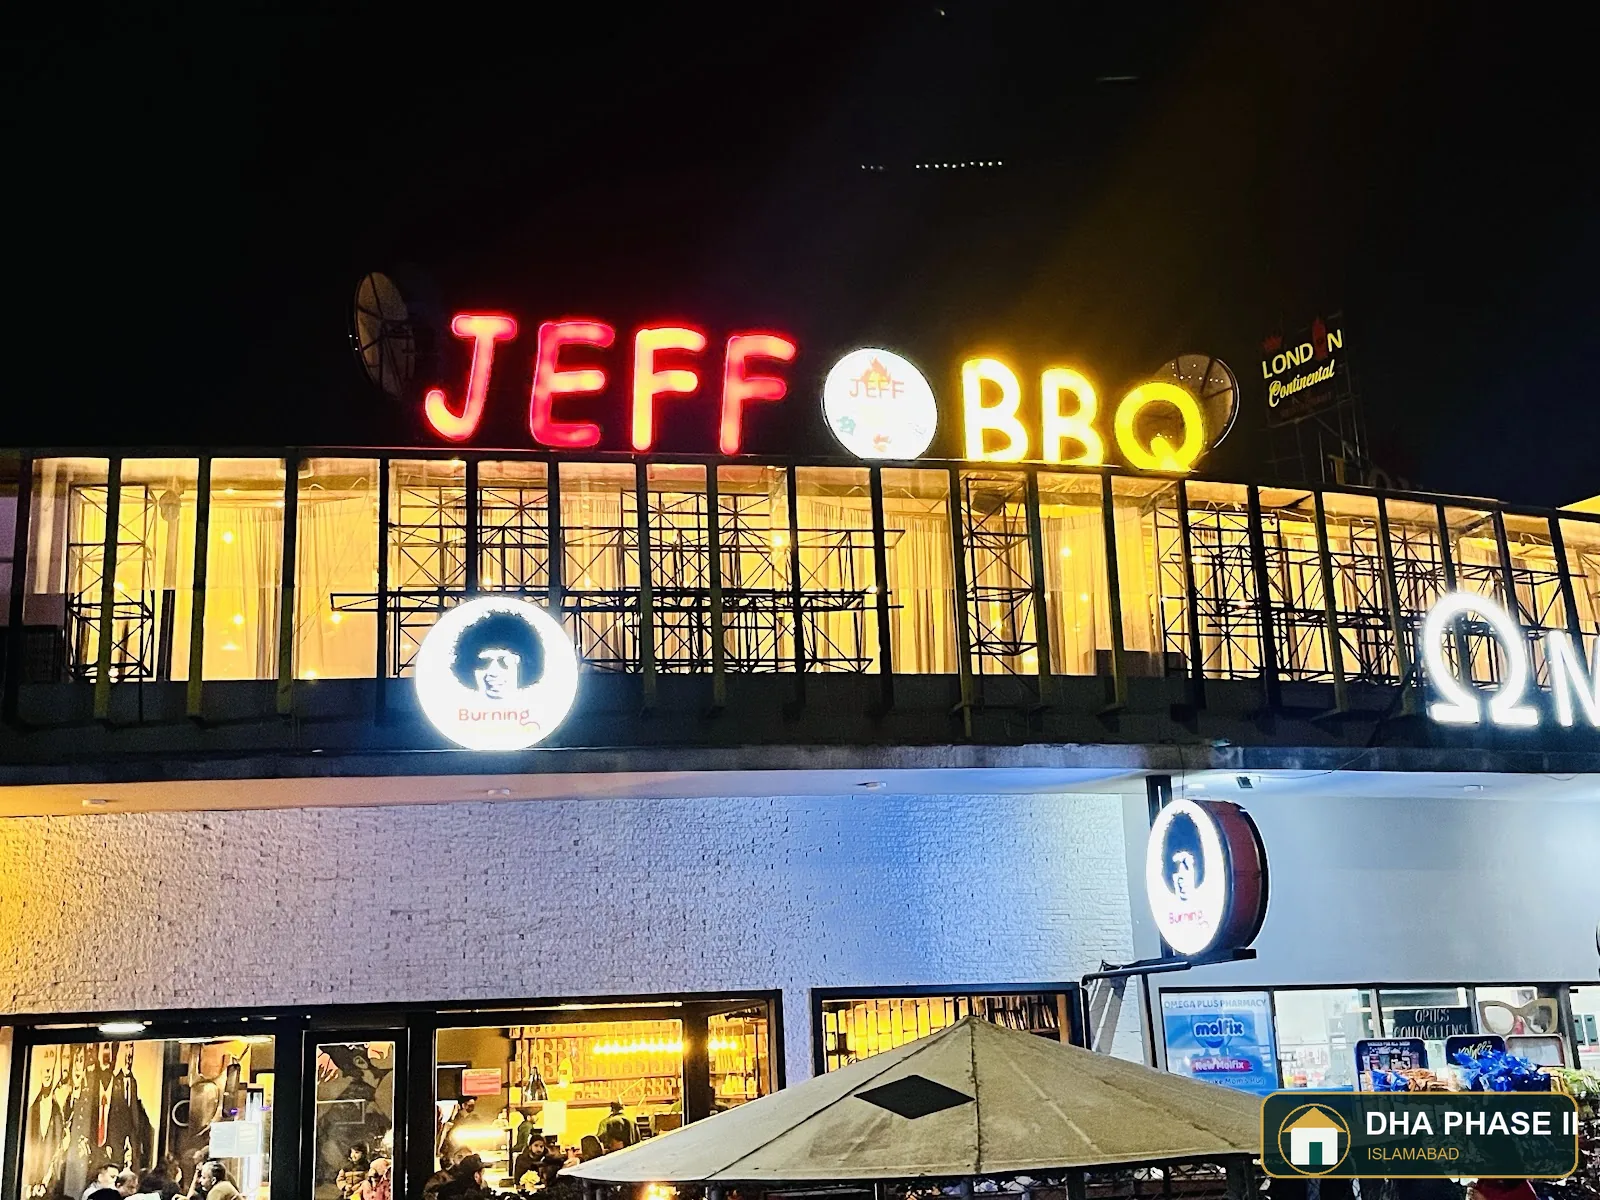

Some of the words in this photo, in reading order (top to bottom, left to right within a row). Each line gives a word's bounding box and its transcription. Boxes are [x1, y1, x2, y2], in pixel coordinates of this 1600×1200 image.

[1262, 329, 1343, 379] LONDN
[425, 314, 796, 455] JEFF
[962, 358, 1203, 471] BBQ
[849, 378, 905, 399] JEFF
[1268, 359, 1335, 408] Continental
[458, 708, 540, 730] Burning
[1164, 1000, 1196, 1009] OMEGA
[1197, 1000, 1218, 1008] PLUS
[1220, 999, 1266, 1008] PHARMACY
[1415, 1008, 1450, 1023] OPTICS
[1195, 1019, 1243, 1036] molfix
